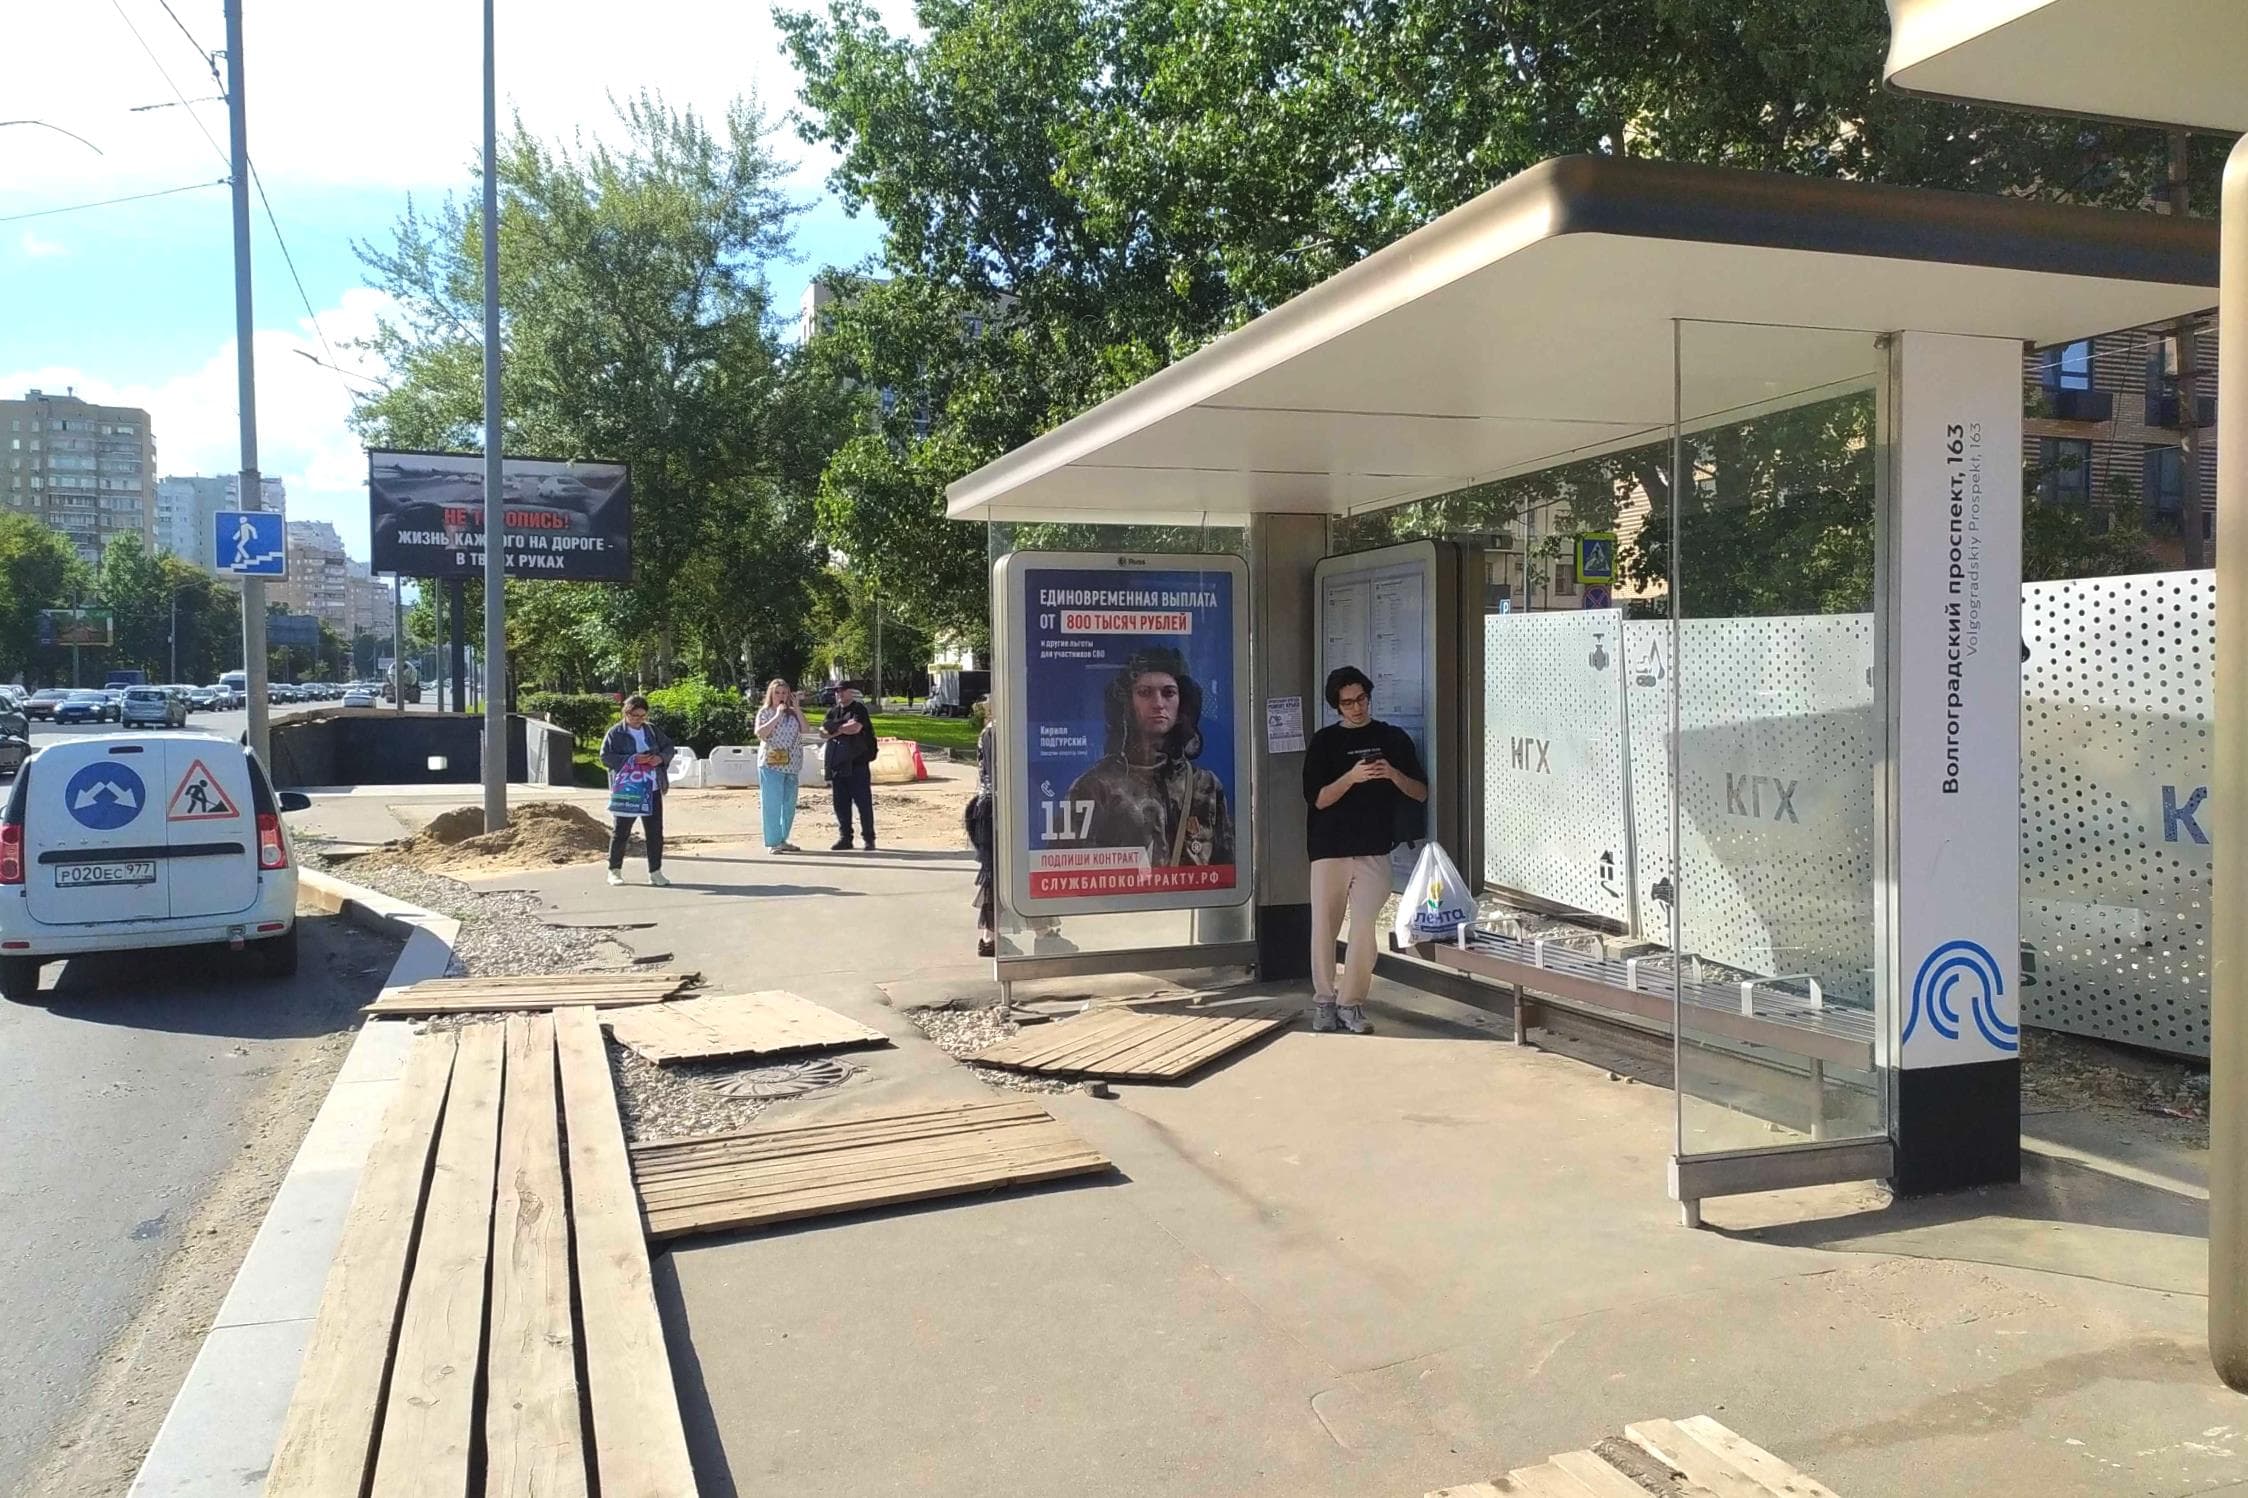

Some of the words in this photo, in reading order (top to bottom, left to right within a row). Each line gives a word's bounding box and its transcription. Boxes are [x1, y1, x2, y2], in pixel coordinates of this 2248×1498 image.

[1947, 424, 1963, 465] 163
[1970, 423, 1981, 448] 163
[1968, 454, 1982, 531] Prospekt,
[444, 508, 466, 526] НЕ
[474, 510, 569, 528] ТОПИСЬ!
[398, 530, 450, 546] ЖИЗНЬ
[454, 532, 525, 548] КАЖГО
[529, 535, 548, 549] НА
[551, 536, 604, 551] ДОРОГЕ
[1949, 472, 1965, 594] проспект,
[456, 552, 466, 566] В
[470, 553, 515, 567] ТВХ
[518, 554, 564, 569] РУКАХ
[1040, 589, 1158, 607] ЕДИНОВРЕМЕННАЯ
[1161, 591, 1218, 608] ВЫПЛАТА
[1967, 537, 1982, 656] Volgogradskiy
[1040, 613, 1056, 630] ОТ
[1066, 614, 1091, 630] 800
[1094, 614, 1136, 631] ТЫСЯЧ
[1140, 612, 1187, 631] РУБЛЕЙ
[1040, 650, 1053, 659] для
[1054, 650, 1091, 660] участников
[1092, 649, 1105, 658] СВО
[1046, 640, 1069, 649] другие
[1070, 640, 1094, 648] льготы
[1943, 602, 1963, 794] Волгоградский
[1040, 725, 1068, 737] Кирилл
[1040, 736, 1088, 748] ПОДГУРСКИЙ
[1725, 772, 1800, 824] КГХ
[1041, 800, 1095, 841] 117
[1041, 852, 1091, 867] ПОДПИШИ
[1093, 851, 1140, 865] КОНТРАКТ
[61, 866, 123, 882] Р020ЕС
[126, 863, 150, 875] 977
[1041, 871, 1220, 891] СЛУЖБАПОКОНТРАКТУ.РФ
